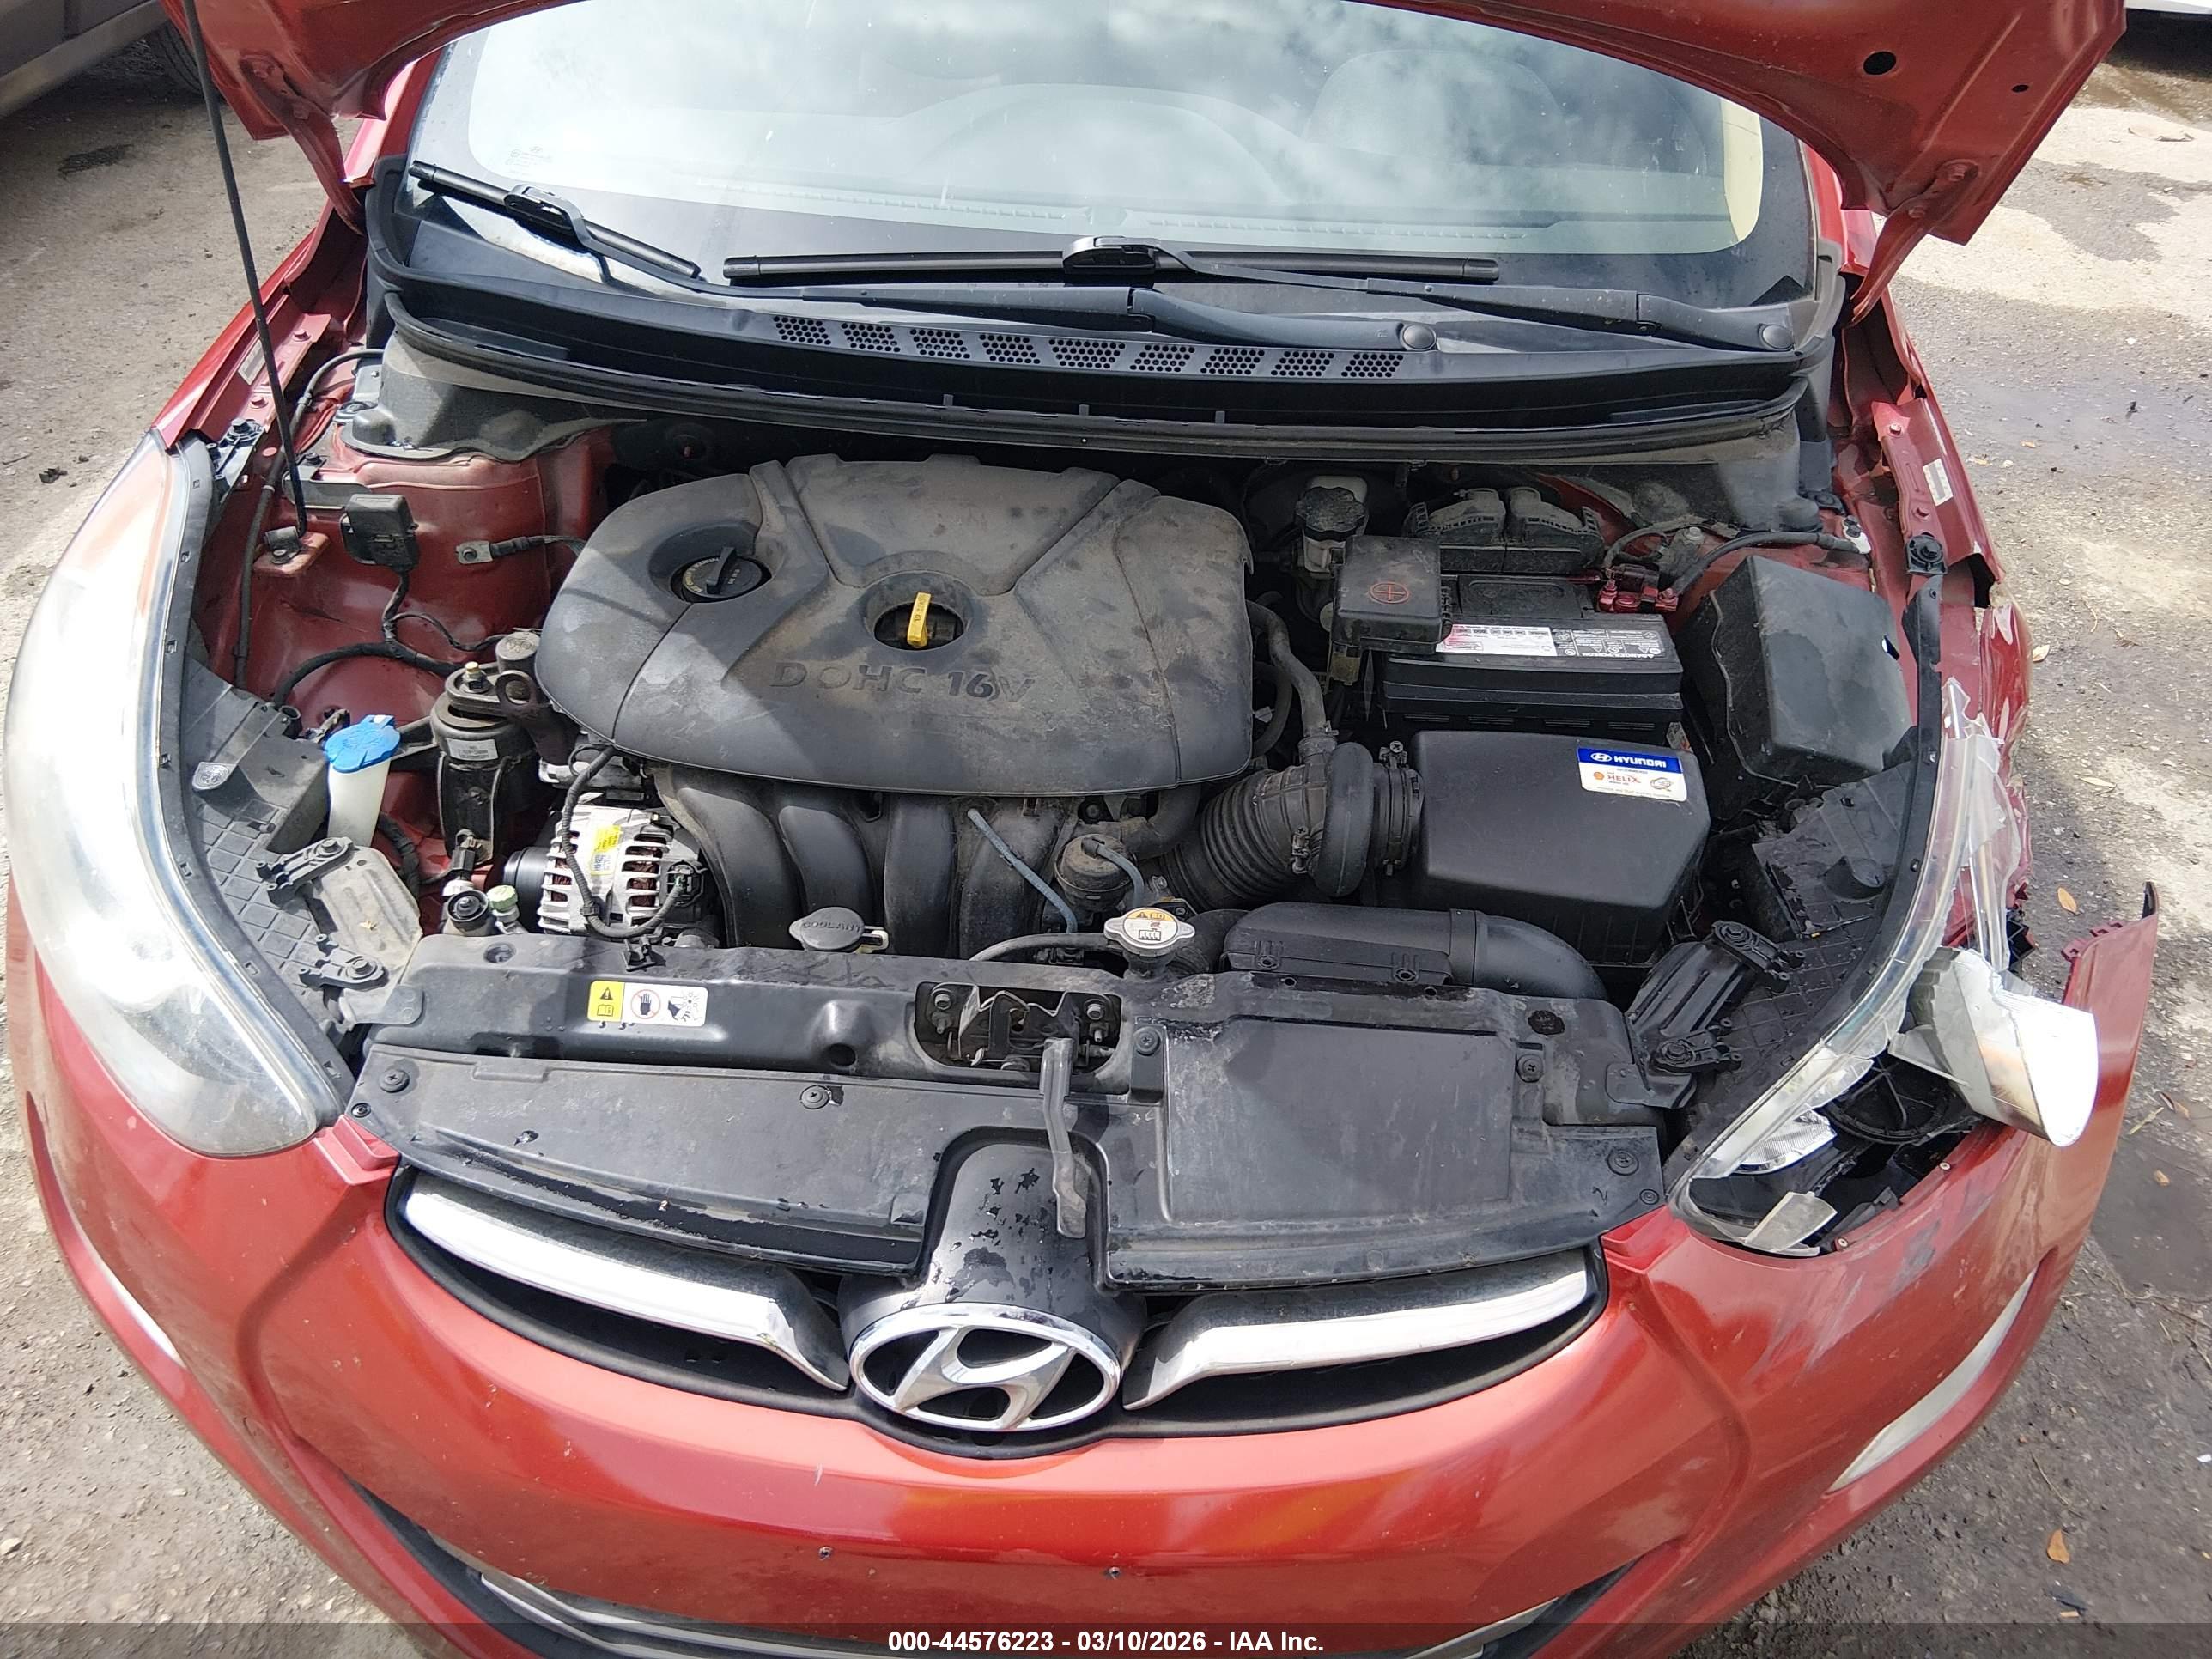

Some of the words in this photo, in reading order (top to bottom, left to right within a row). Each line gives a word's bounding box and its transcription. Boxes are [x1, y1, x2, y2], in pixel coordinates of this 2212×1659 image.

[769, 661, 927, 695] DOHC
[947, 671, 1036, 702] 16V
[1613, 756, 1667, 769] HYUNDAI
[1607, 774, 1642, 784] HELIX
[802, 920, 865, 933] COOLANT
